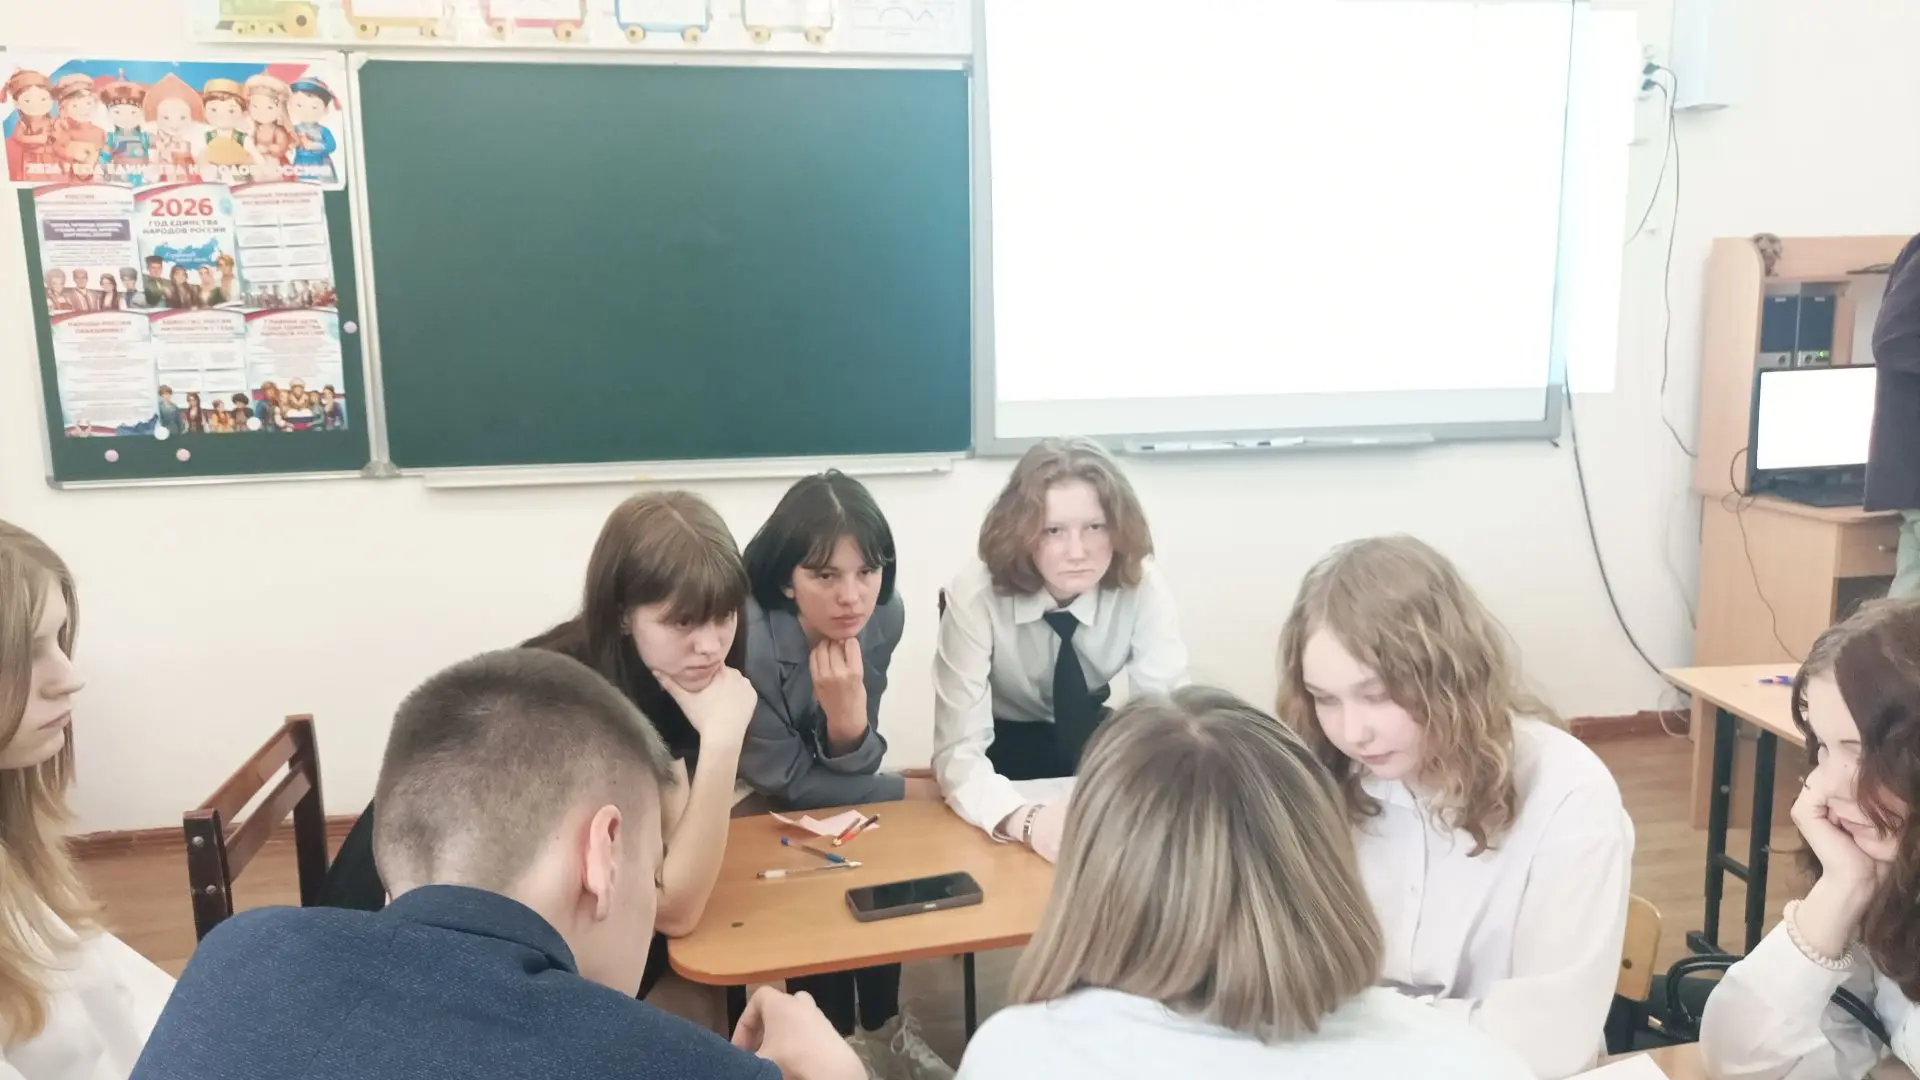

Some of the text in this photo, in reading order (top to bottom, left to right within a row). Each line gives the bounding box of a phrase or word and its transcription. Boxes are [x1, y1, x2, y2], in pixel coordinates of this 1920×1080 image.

[188, 164, 259, 176] НОДО
[262, 164, 333, 176] ССИИ
[150, 198, 214, 217] 2026
[142, 227, 188, 235] НАРОДОВ
